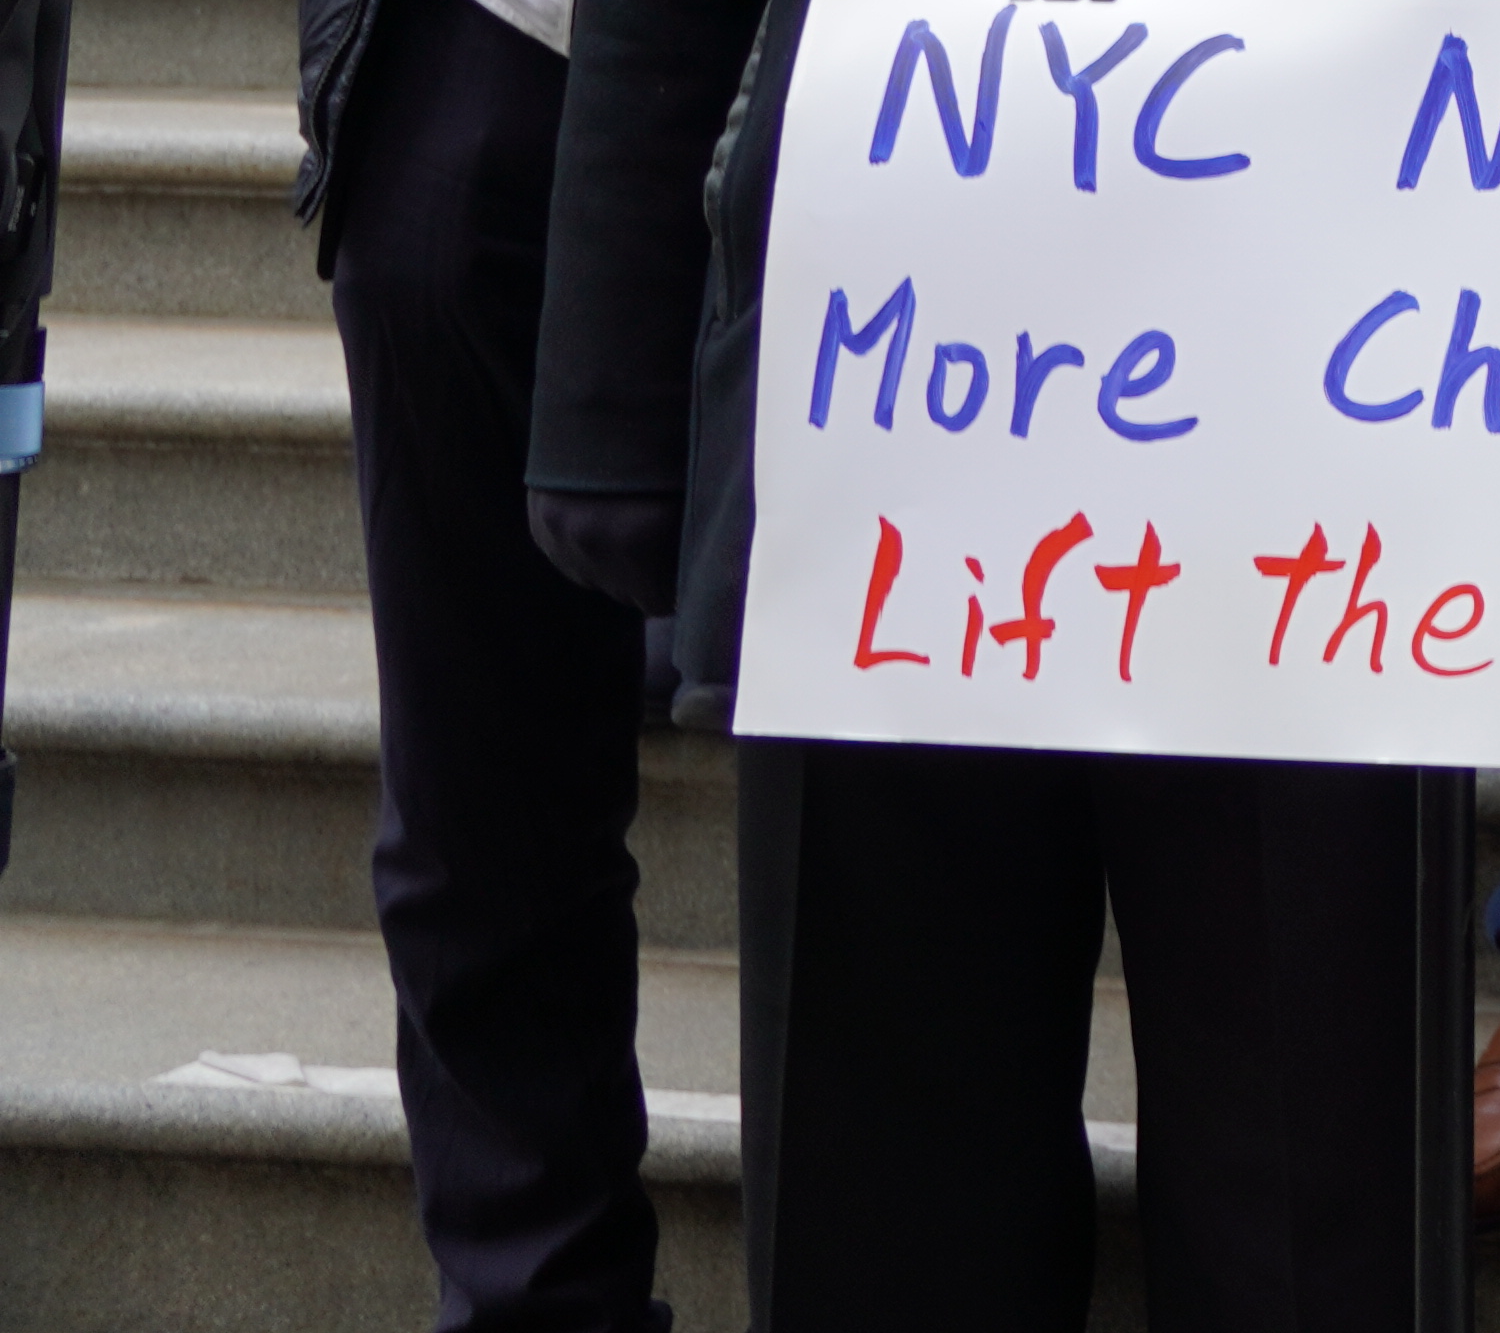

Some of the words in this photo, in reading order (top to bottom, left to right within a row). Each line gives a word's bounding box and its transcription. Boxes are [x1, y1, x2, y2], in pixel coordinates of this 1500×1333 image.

[869, 3, 1252, 193] NYC
[806, 274, 1201, 444] More
[852, 511, 1182, 684] Lift
[1253, 520, 1495, 678] the
